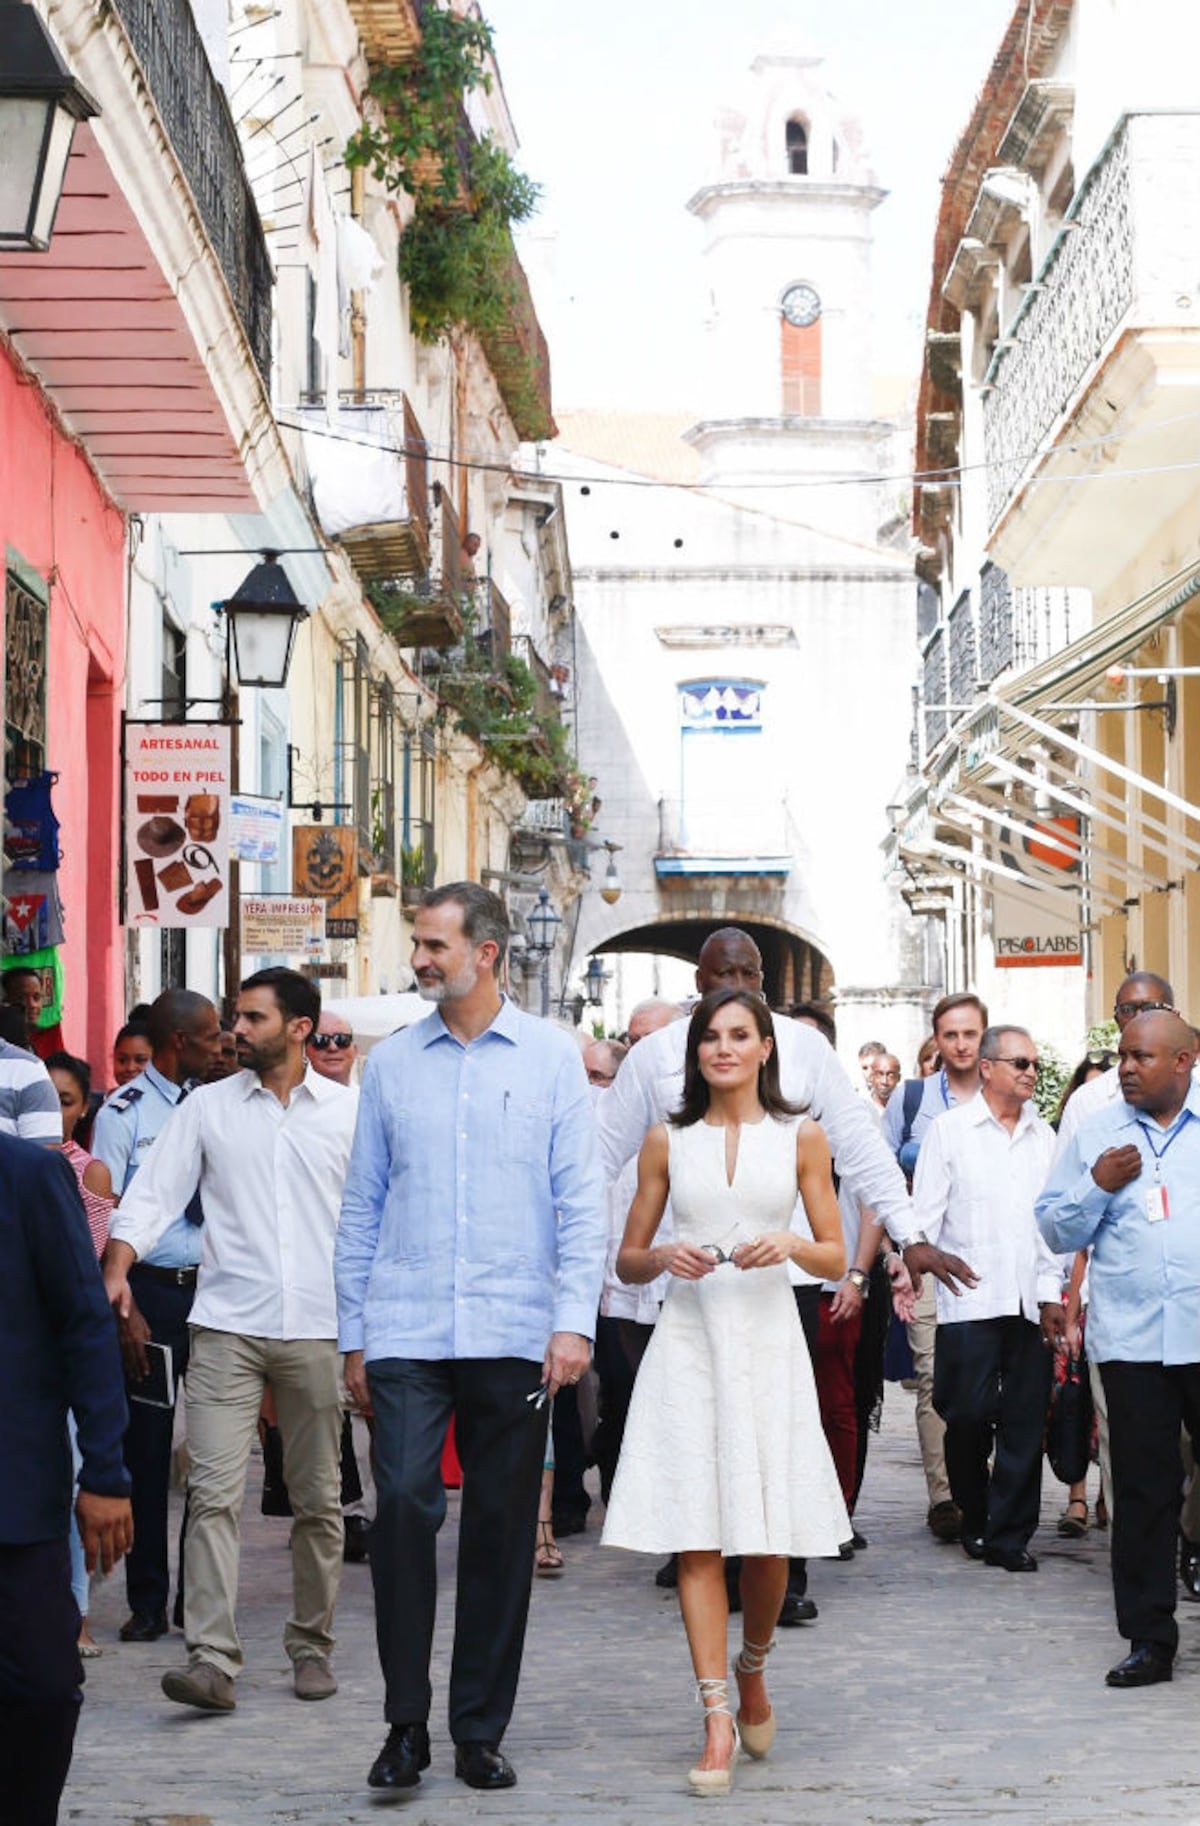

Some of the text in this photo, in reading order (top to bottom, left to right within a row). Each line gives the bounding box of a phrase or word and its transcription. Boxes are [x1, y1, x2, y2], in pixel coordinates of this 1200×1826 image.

[140, 739, 219, 750] ARTESANAL
[133, 771, 225, 783] TODO EN PIEL
